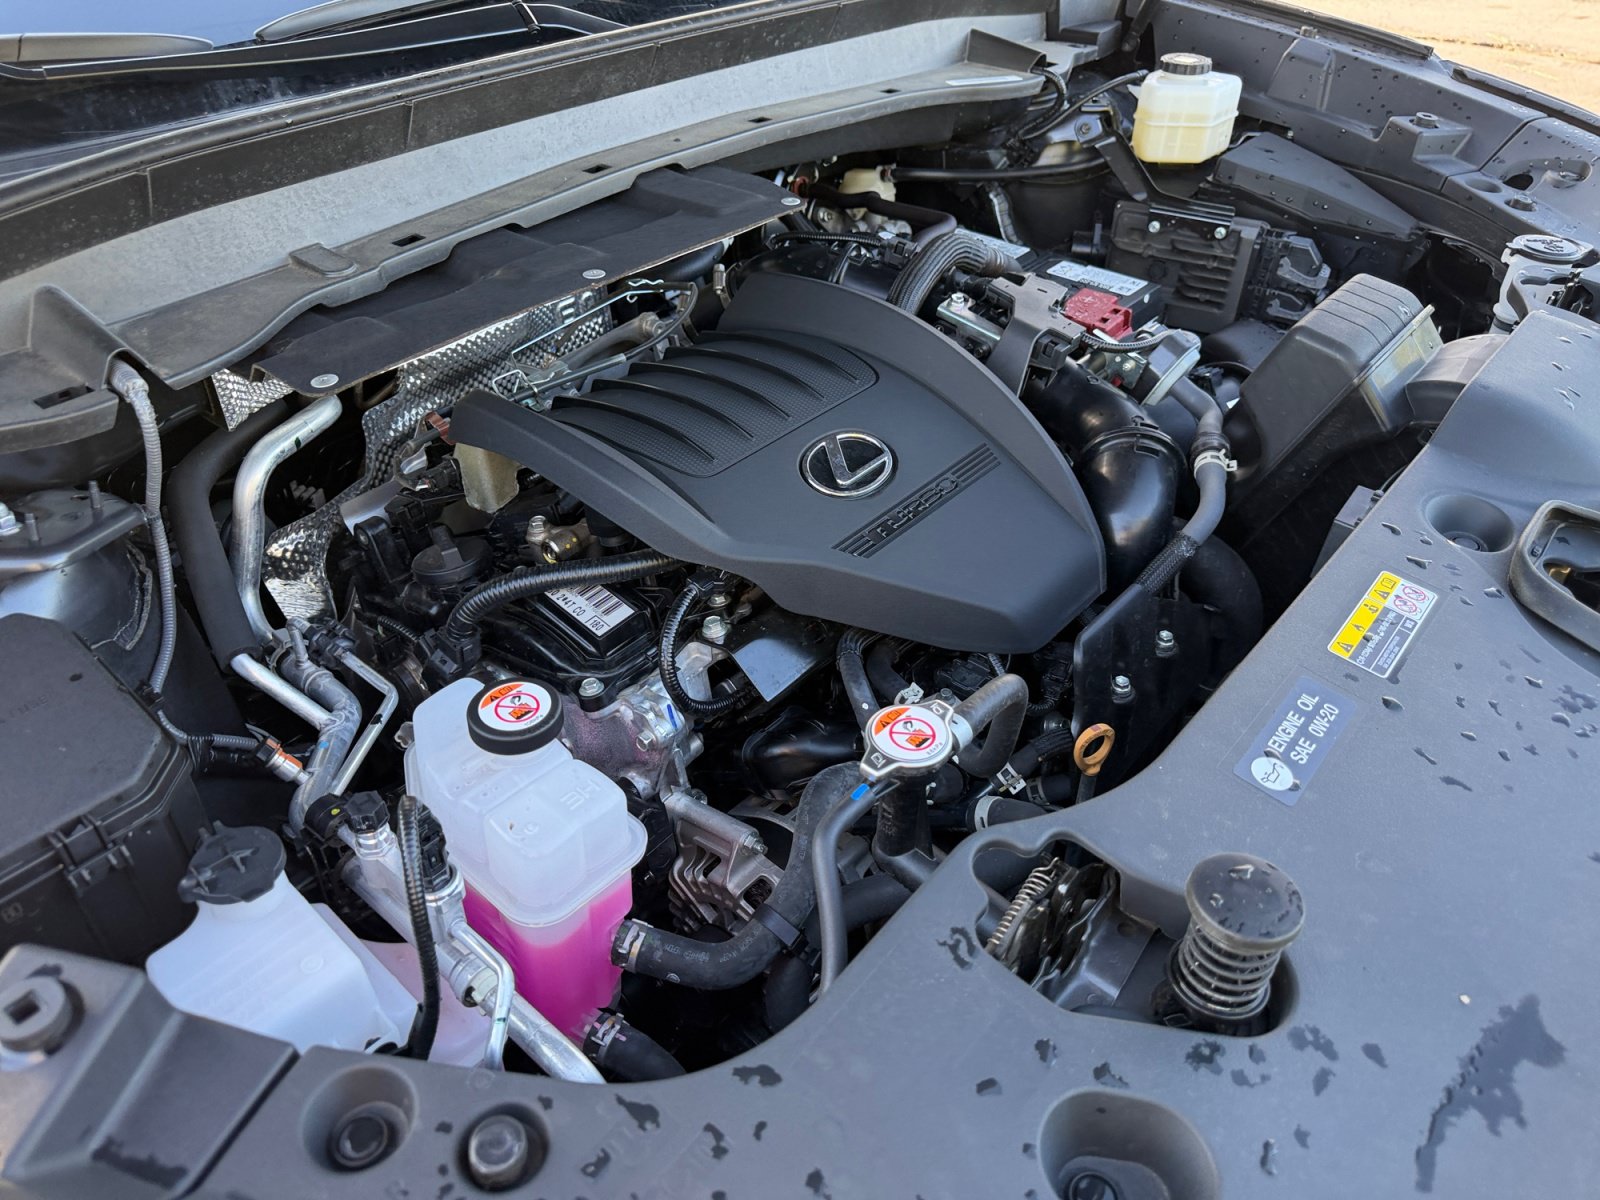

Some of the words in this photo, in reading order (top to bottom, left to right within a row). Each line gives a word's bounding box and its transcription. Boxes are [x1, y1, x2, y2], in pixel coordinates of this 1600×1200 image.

[867, 476, 959, 544] TURBO
[589, 619, 605, 632] 180
[1267, 709, 1305, 753] ENGINE
[1297, 693, 1320, 711] OIL
[1290, 736, 1317, 765] SAE
[1308, 703, 1339, 737] 0W-20
